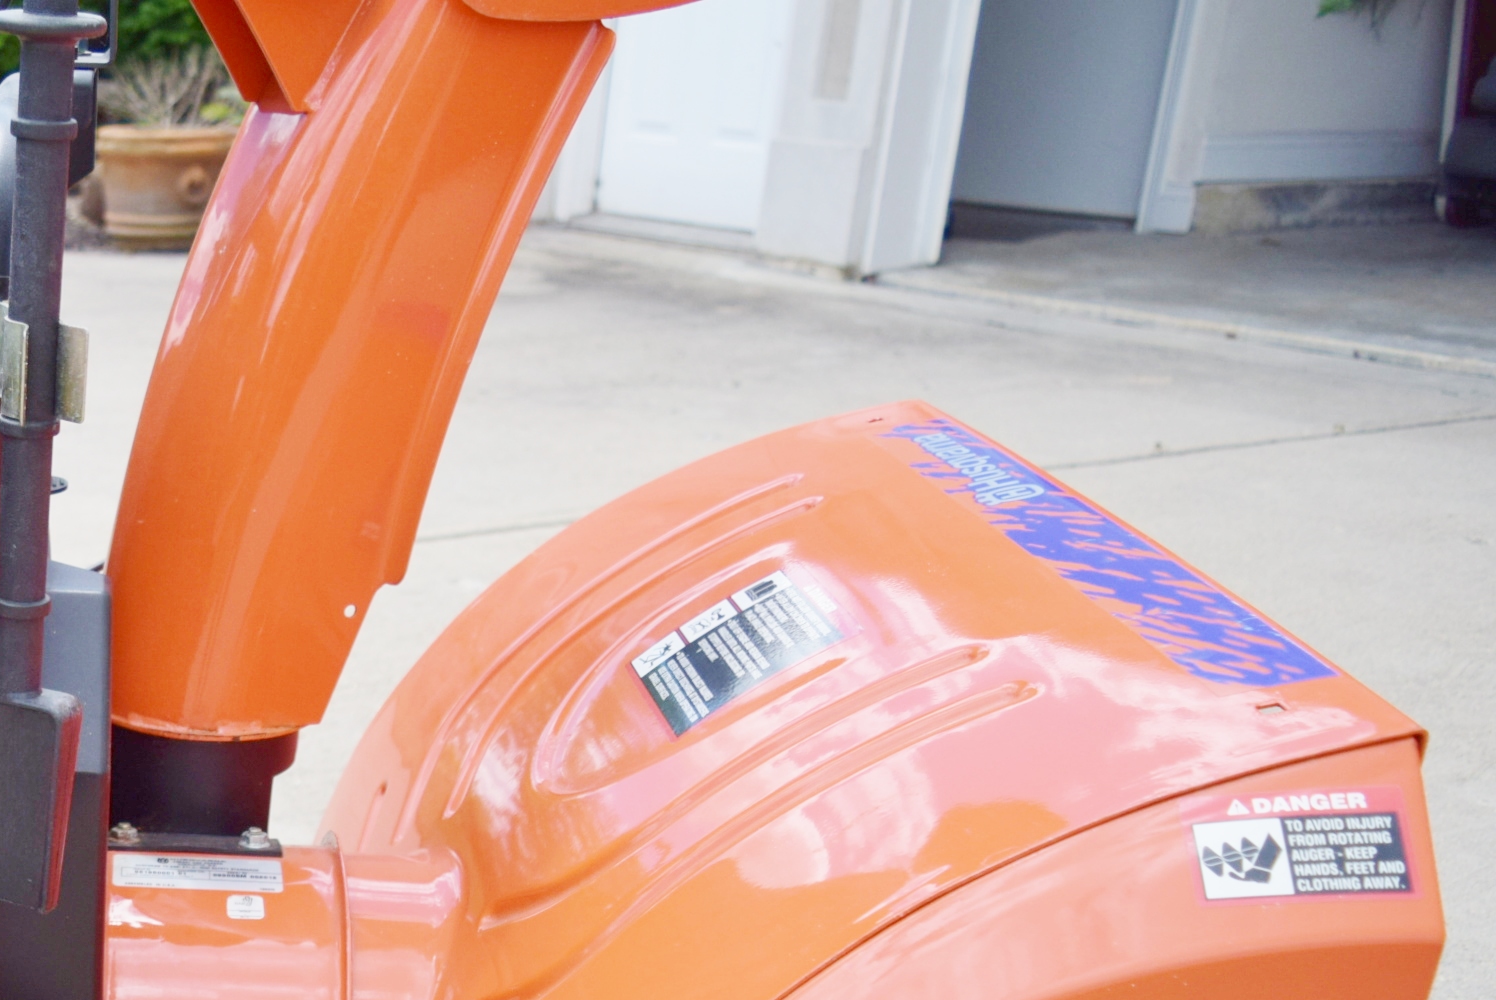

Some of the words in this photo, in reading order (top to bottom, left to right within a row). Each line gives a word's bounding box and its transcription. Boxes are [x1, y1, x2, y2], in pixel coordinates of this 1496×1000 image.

[913, 432, 1021, 494] Husqvarna
[1252, 792, 1368, 814] DANGER
[1284, 819, 1303, 832] TO
[1305, 817, 1344, 831] AVOID
[1346, 815, 1392, 830] INJURY
[1288, 833, 1327, 847] FROM
[1328, 830, 1393, 845] ROTATING
[1292, 847, 1336, 861] AUGER
[1344, 846, 1378, 859] KEEP
[1344, 861, 1376, 875] FEET
[1378, 860, 1405, 874] AND
[1297, 876, 1362, 892] CLOTHING
[1363, 875, 1406, 890] AWAY.
